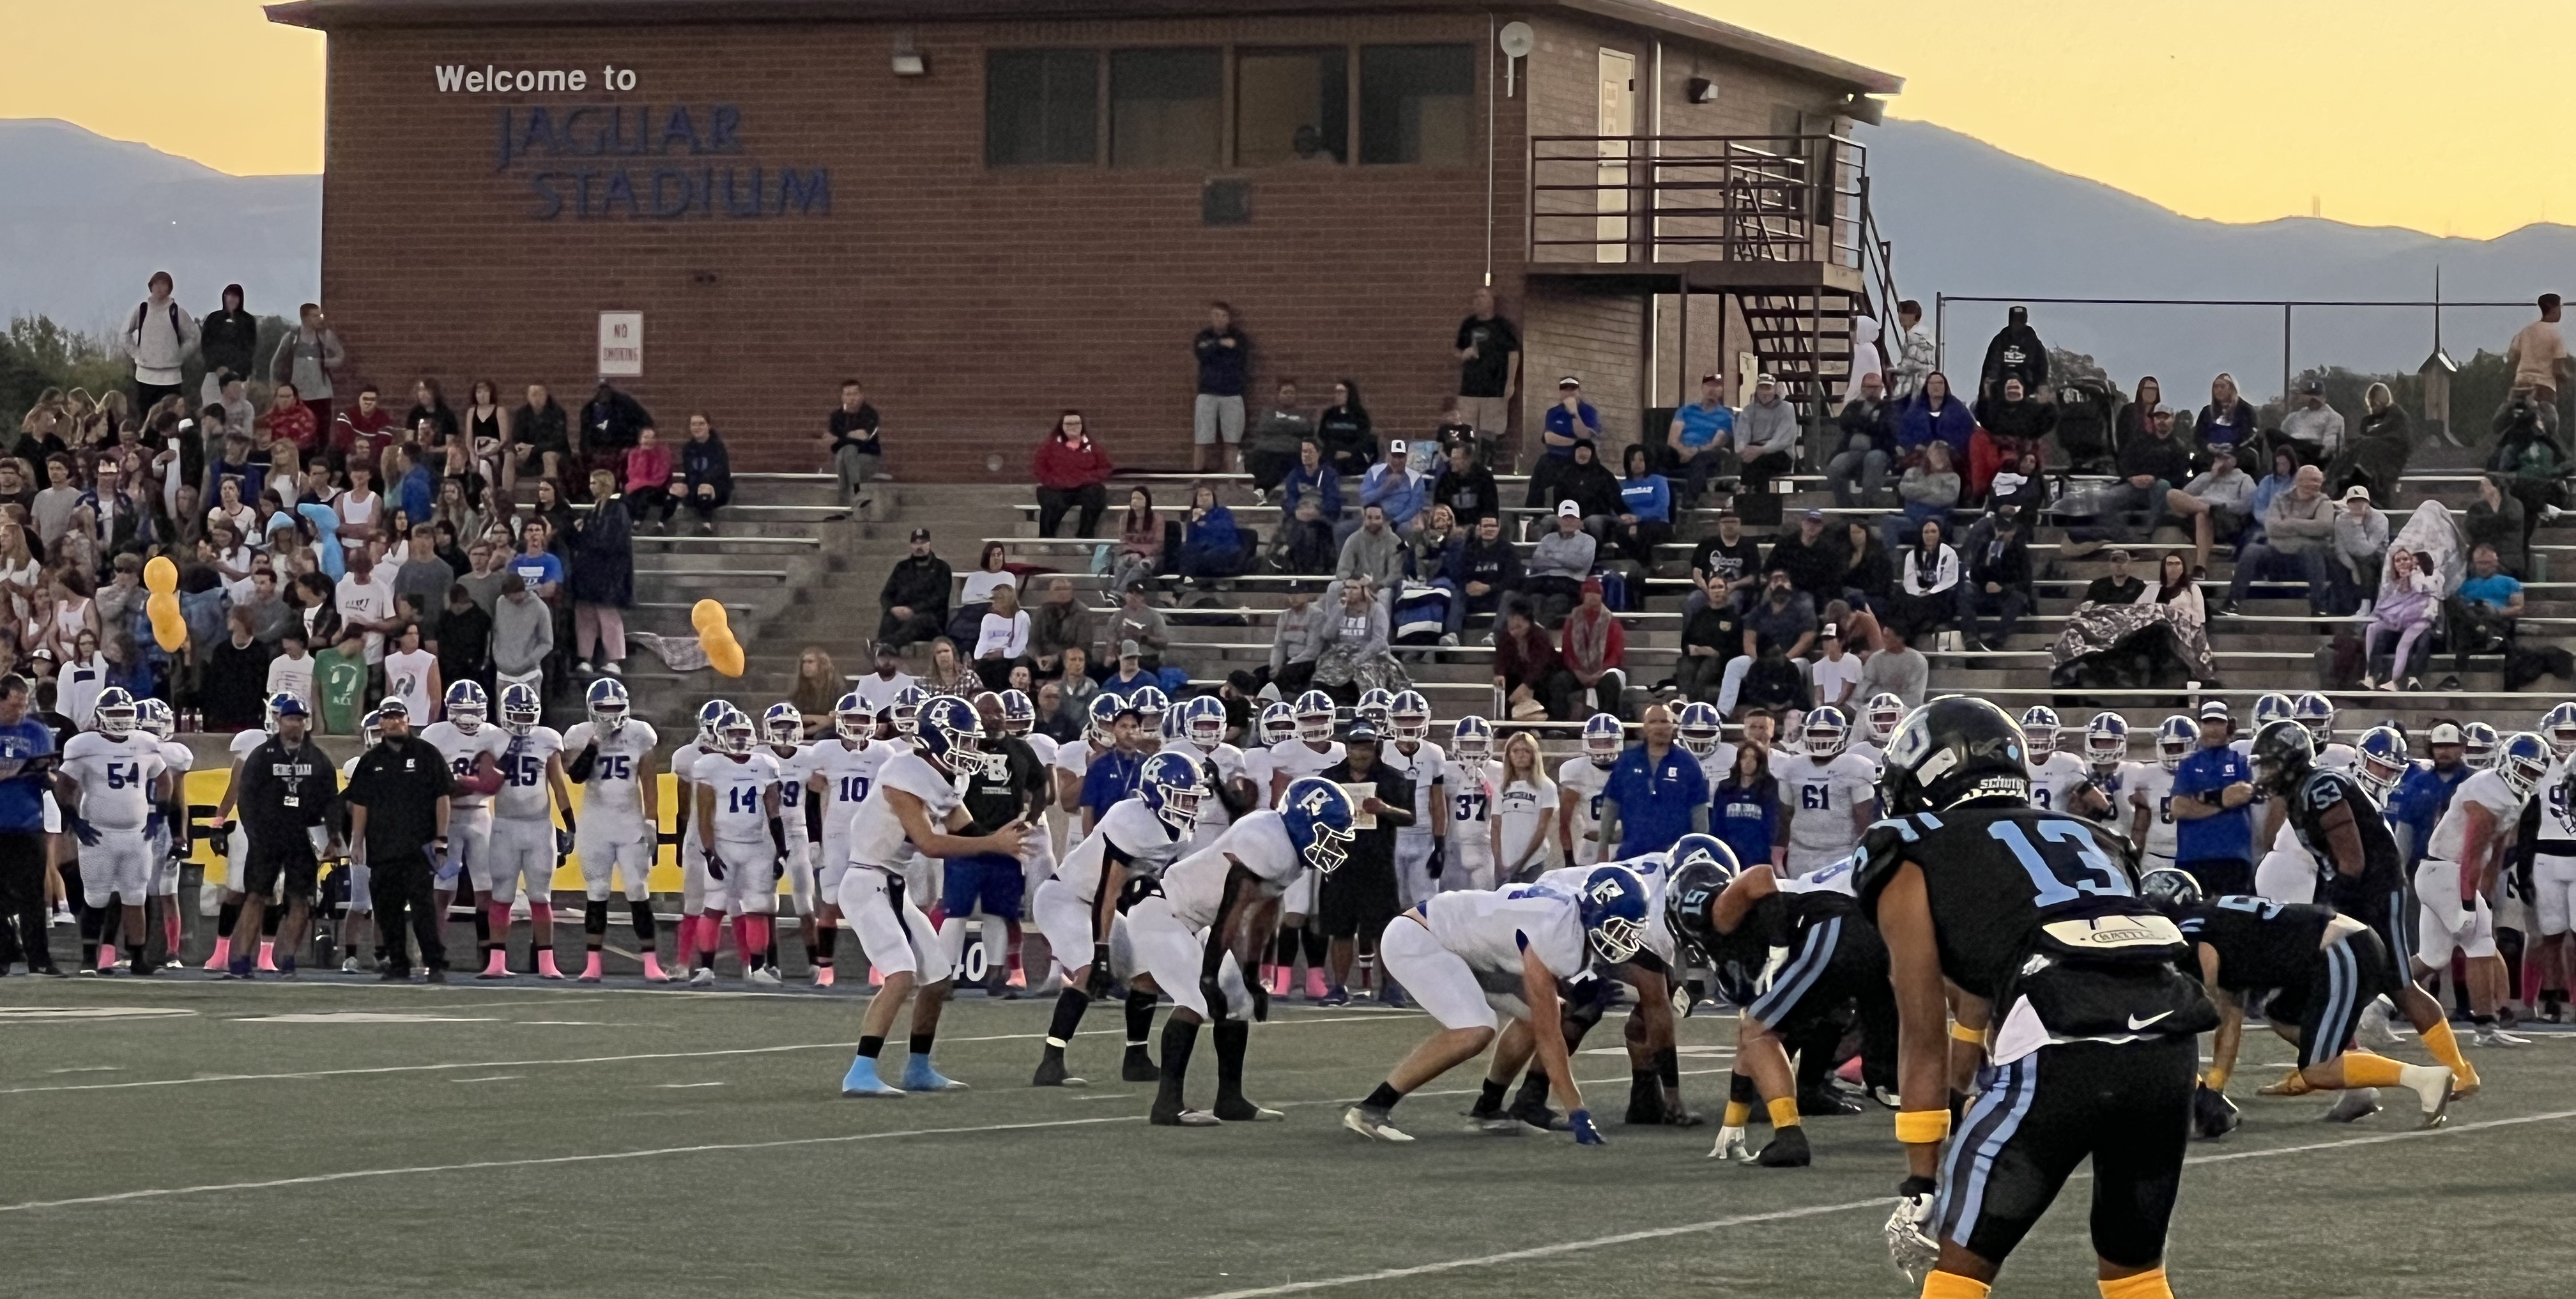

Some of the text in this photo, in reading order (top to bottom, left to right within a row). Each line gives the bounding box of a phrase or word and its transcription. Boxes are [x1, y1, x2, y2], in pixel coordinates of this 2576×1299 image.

[435, 65, 636, 92] Welcome to
[496, 104, 743, 171] JAGUAR
[532, 167, 831, 220] STADIUM
[613, 323, 628, 339] NO
[107, 762, 139, 789] 54
[504, 756, 539, 787] 45
[596, 755, 631, 780] 75
[729, 786, 757, 813] 14
[839, 776, 869, 803] 10
[1802, 784, 1830, 810] 61
[1455, 793, 1488, 822] 37
[1987, 819, 2135, 907] 13
